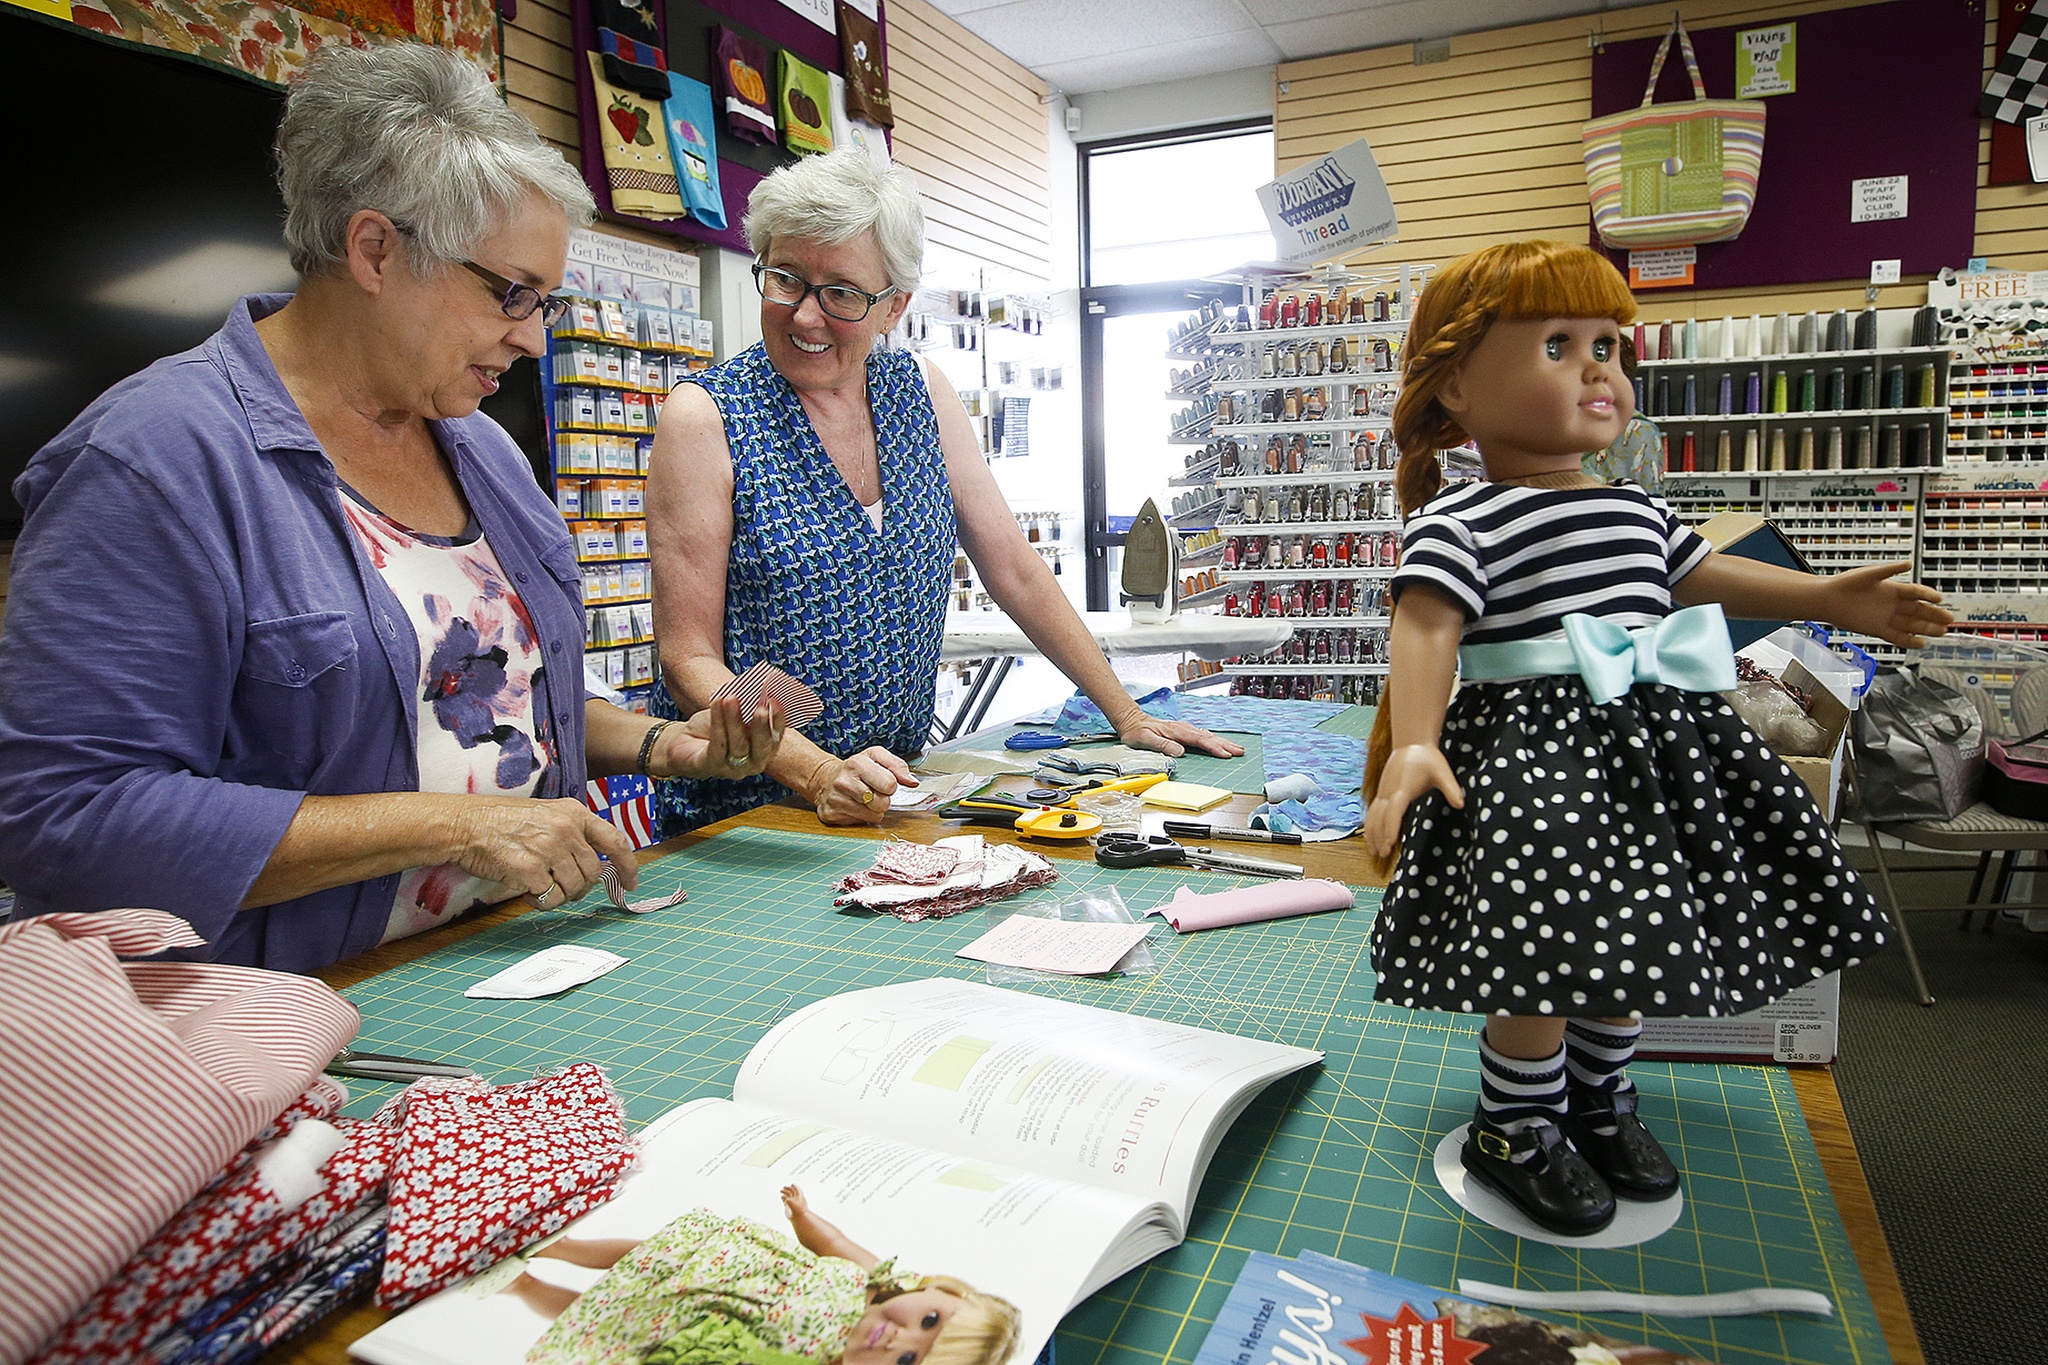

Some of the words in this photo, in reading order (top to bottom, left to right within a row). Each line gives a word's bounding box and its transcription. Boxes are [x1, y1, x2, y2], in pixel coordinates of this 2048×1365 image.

[1748, 32, 1786, 44] Viking
[1754, 49, 1780, 62] Pfaff
[1862, 194, 1896, 203] VIKING
[1863, 186, 1896, 194] PFAFF
[1297, 213, 1350, 245] Thread
[591, 234, 622, 250] Coupon
[624, 242, 644, 254] Inside
[647, 247, 667, 260] Every
[572, 242, 592, 258] Get
[596, 248, 618, 264] Free
[622, 254, 661, 274] Needles
[663, 263, 688, 280] Now!
[1960, 279, 2027, 299] FREE
[1665, 486, 1725, 498] MADEIRA
[1811, 485, 1876, 496] MADEIRA
[1974, 479, 2035, 490] MADEIRA
[1968, 611, 2028, 622] MADEIRA
[970, 1112, 982, 1136] bodice
[1113, 1096, 1160, 1174] Ruffles
[1089, 1135, 1104, 1168] loaded
[1240, 1298, 1276, 1350] Hentzel
[1386, 1327, 1402, 1342] fit,
[1408, 1324, 1424, 1351] small,
[1432, 1322, 1444, 1349] more
[1429, 1348, 1444, 1358] &
